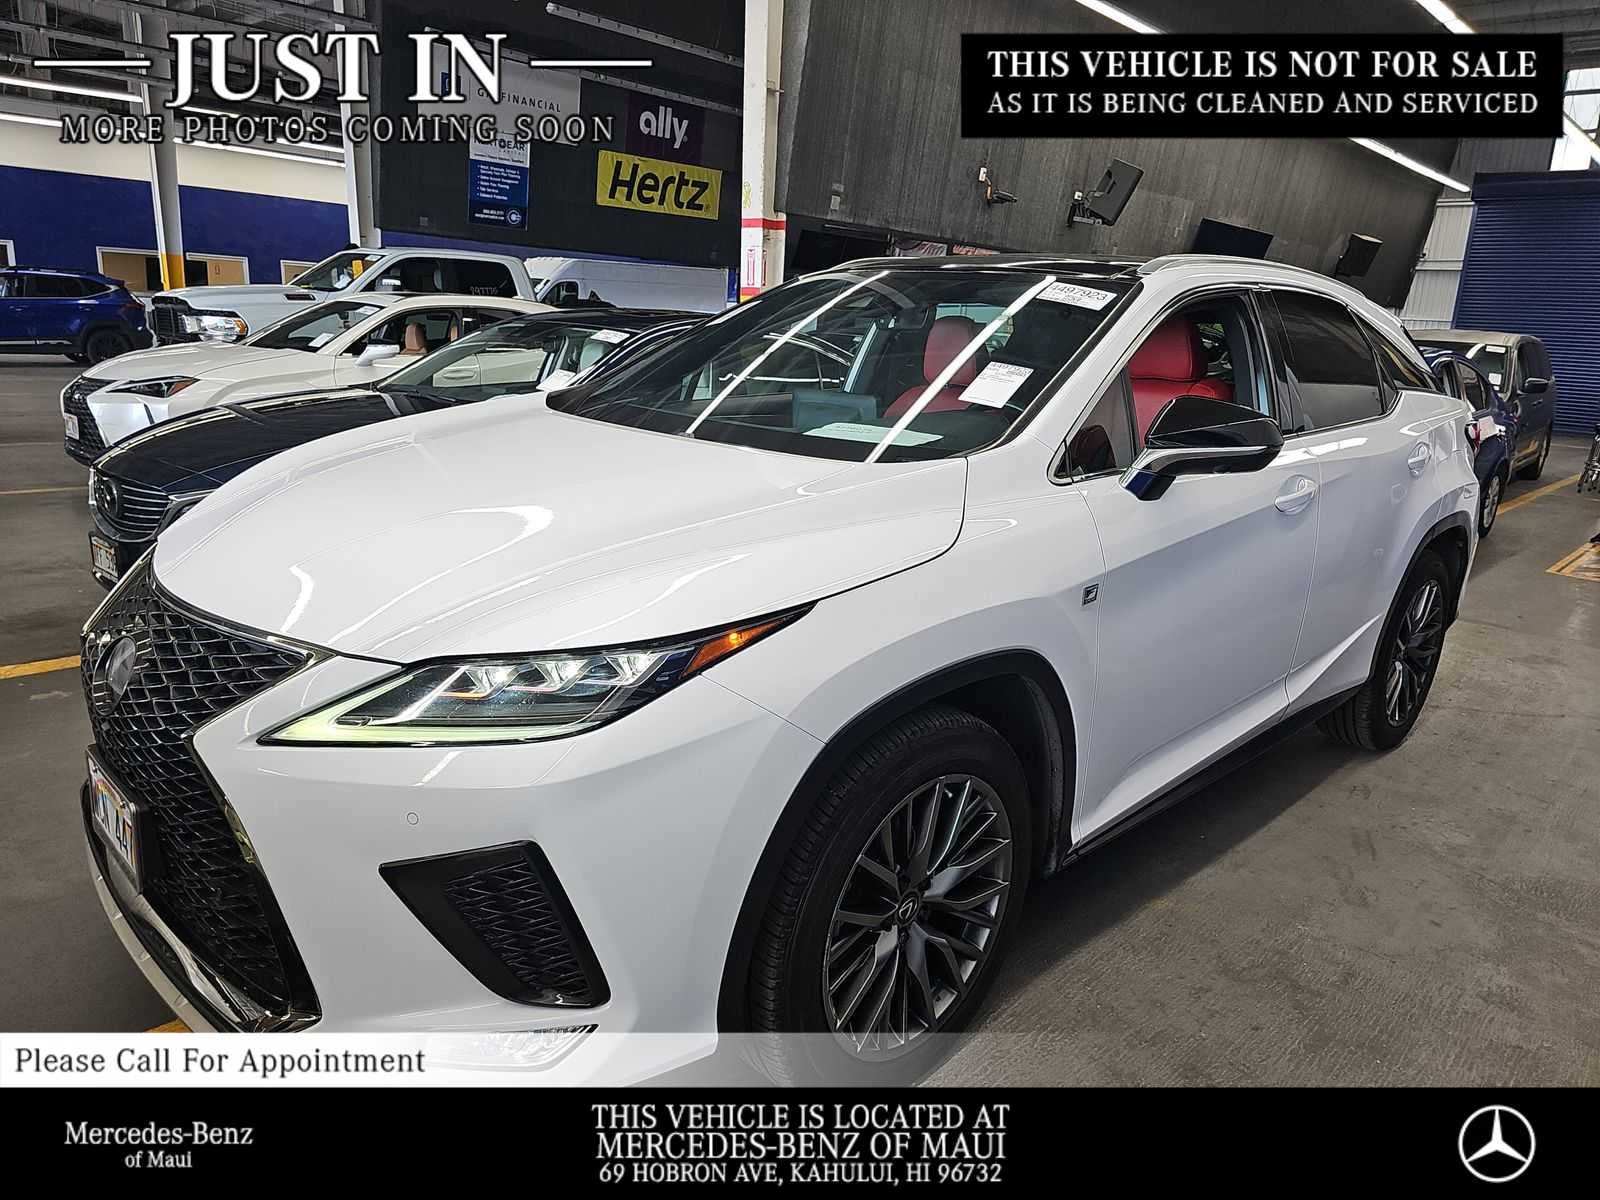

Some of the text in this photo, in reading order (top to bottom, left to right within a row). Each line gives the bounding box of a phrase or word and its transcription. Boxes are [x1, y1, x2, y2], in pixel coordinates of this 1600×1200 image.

[501, 92, 561, 112] FINANCIAL
[639, 105, 689, 149] ally
[608, 160, 710, 211] Hertz
